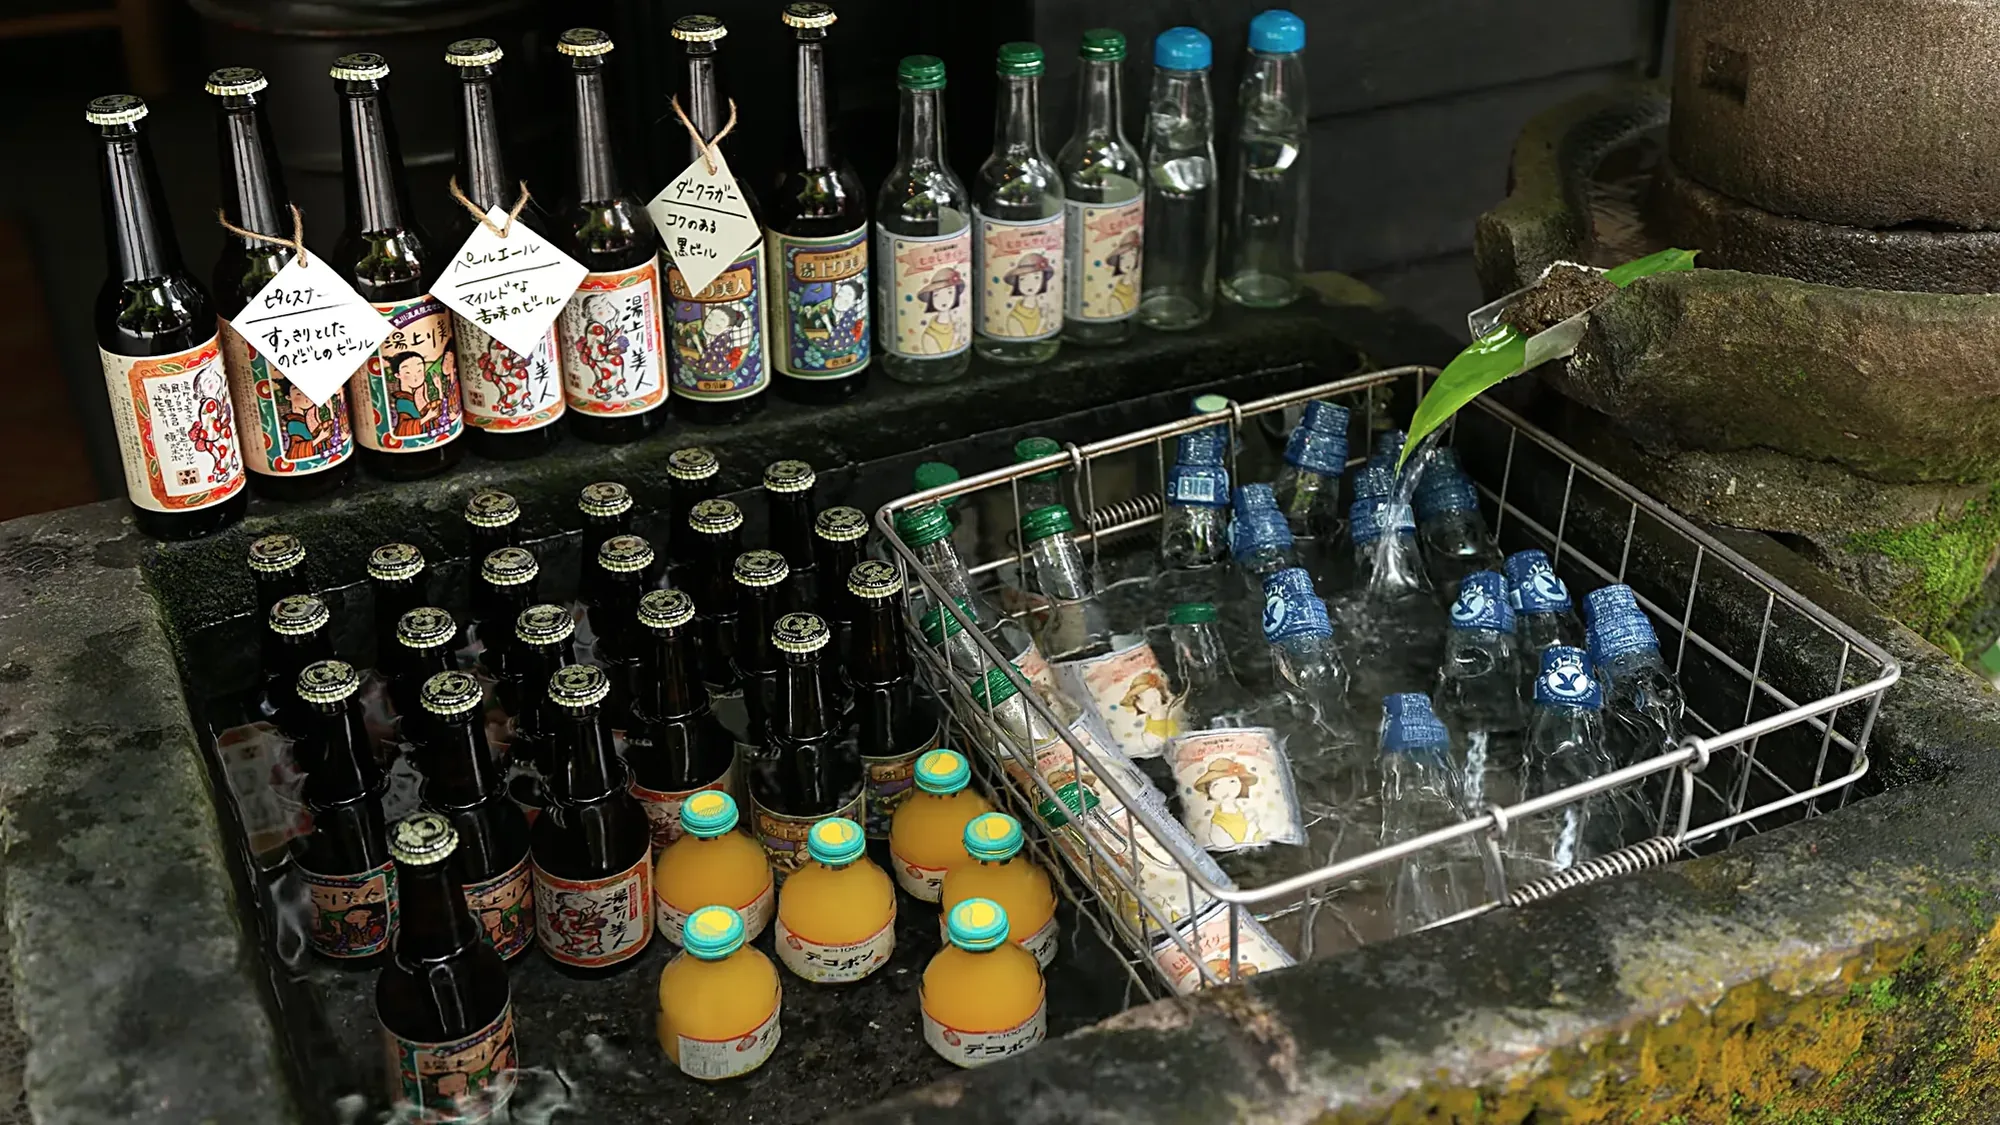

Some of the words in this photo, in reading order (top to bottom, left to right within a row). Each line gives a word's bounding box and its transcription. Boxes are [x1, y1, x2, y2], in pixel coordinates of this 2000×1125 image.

[676, 178, 738, 203] ダークラガー
[666, 213, 717, 234] コクのある
[454, 243, 541, 273] ペールエール
[674, 236, 717, 259] 黒ビール
[264, 287, 330, 309] ピルスナー
[458, 280, 529, 306] マイルドな
[673, 278, 748, 299] 湯り美人
[475, 294, 562, 325] 苦味のビール
[261, 321, 346, 353] すっきりとした
[622, 294, 653, 391] 湯上り美人
[277, 337, 375, 368] のどごしのビール
[534, 334, 556, 403] り美人
[804, 948, 875, 971] デコポン
[963, 1026, 1038, 1055] デコポン
